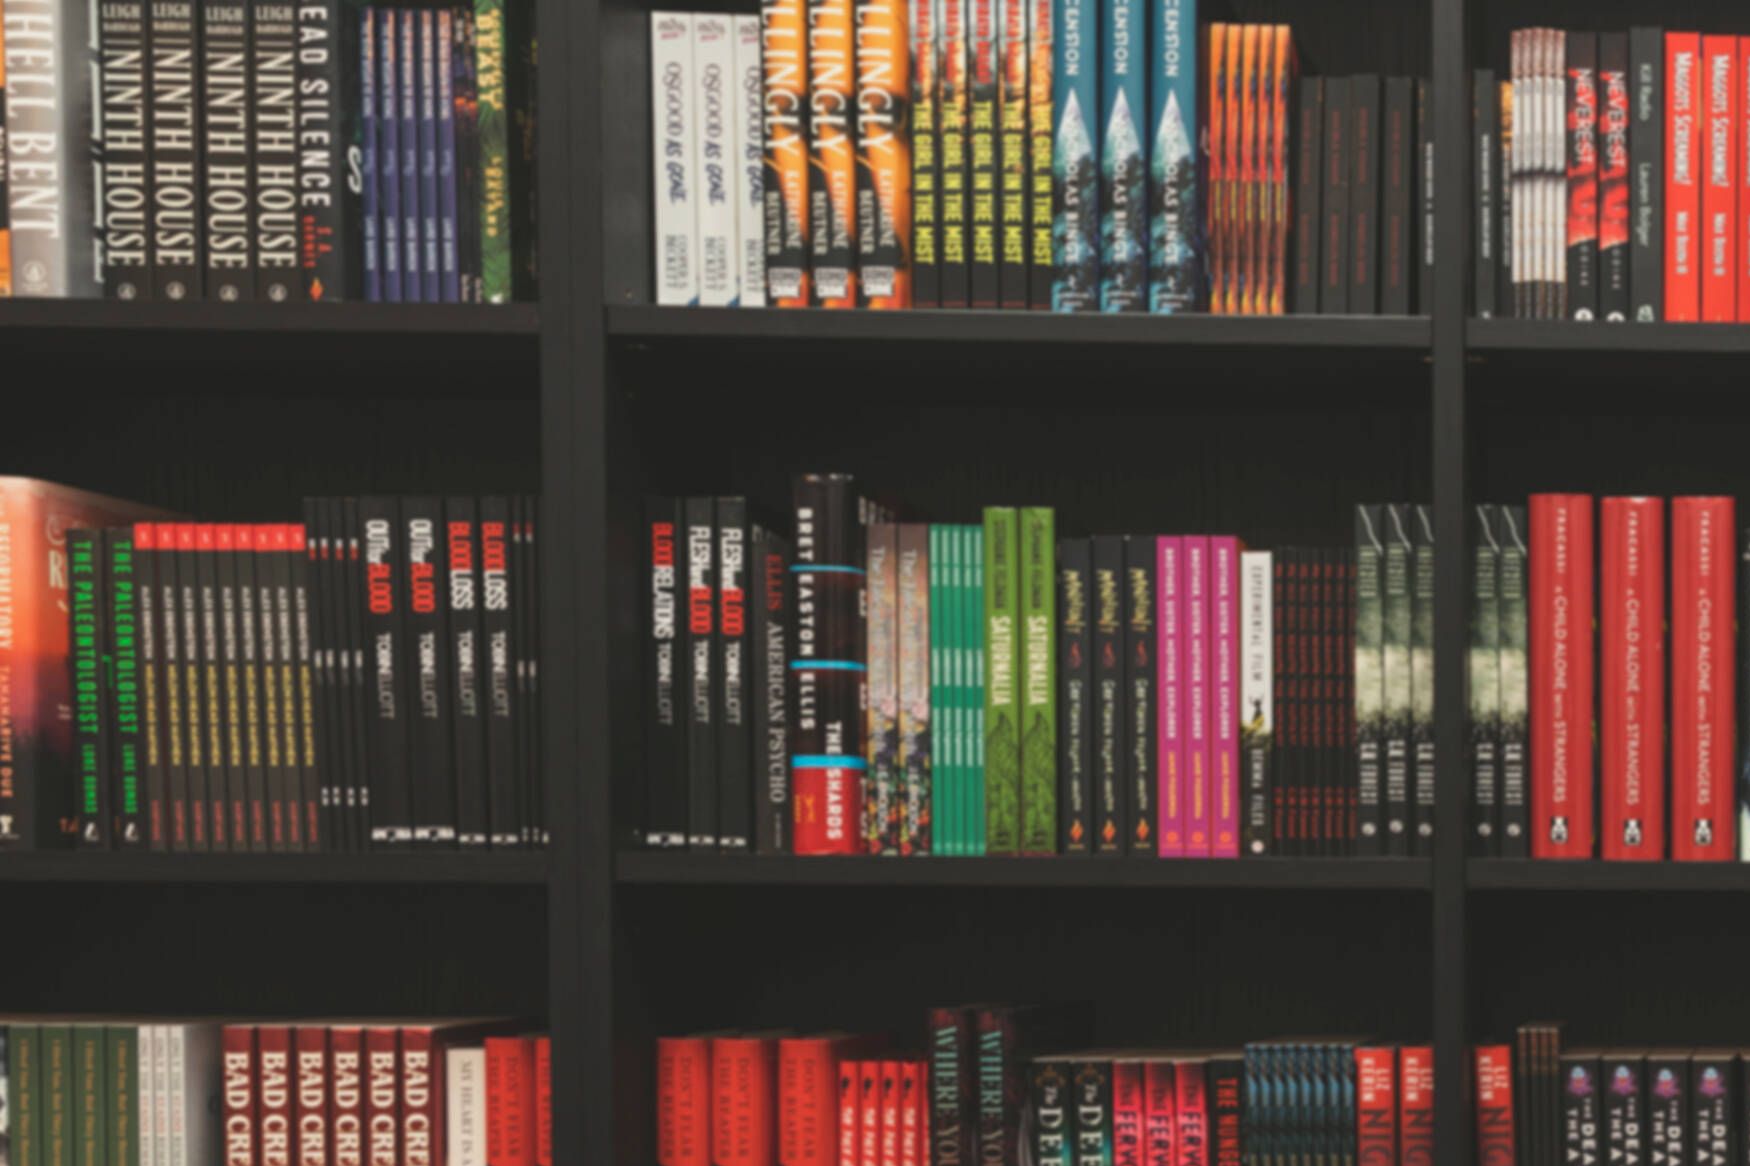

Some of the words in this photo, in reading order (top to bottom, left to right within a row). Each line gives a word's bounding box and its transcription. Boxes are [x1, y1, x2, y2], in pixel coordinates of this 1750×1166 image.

[103, 3, 141, 19] LEIGH
[4, 11, 55, 119] HELL
[105, 49, 143, 152] NINTH
[663, 61, 681, 137] OSGOOD
[301, 78, 331, 208] SILENCE
[665, 139, 682, 159] AS
[973, 101, 993, 130] THE
[1575, 68, 1597, 164] NEVEREST
[9, 131, 58, 240] BENT
[105, 162, 145, 267] HOUSE
[974, 226, 994, 264] MIST
[73, 541, 93, 573] THE
[797, 507, 814, 562] BRET
[798, 574, 815, 657] EASTON
[75, 581, 98, 734] PALEONTOLOGIST
[767, 621, 786, 723] AMERICAN
[990, 616, 1012, 706] SATURNALIA
[1554, 644, 1567, 690] ALONE
[799, 672, 816, 731] ELLIS
[825, 721, 843, 756] THE
[769, 725, 786, 803] PSYCHO
[1553, 721, 1567, 803] STRANGERS
[826, 768, 843, 841] SHARDS
[225, 1051, 250, 1109] BAD
[934, 1026, 960, 1120] WHERE
[1216, 1077, 1237, 1109] THE
[1567, 1108, 1579, 1141] THE
[1567, 1149, 1580, 1163] A
